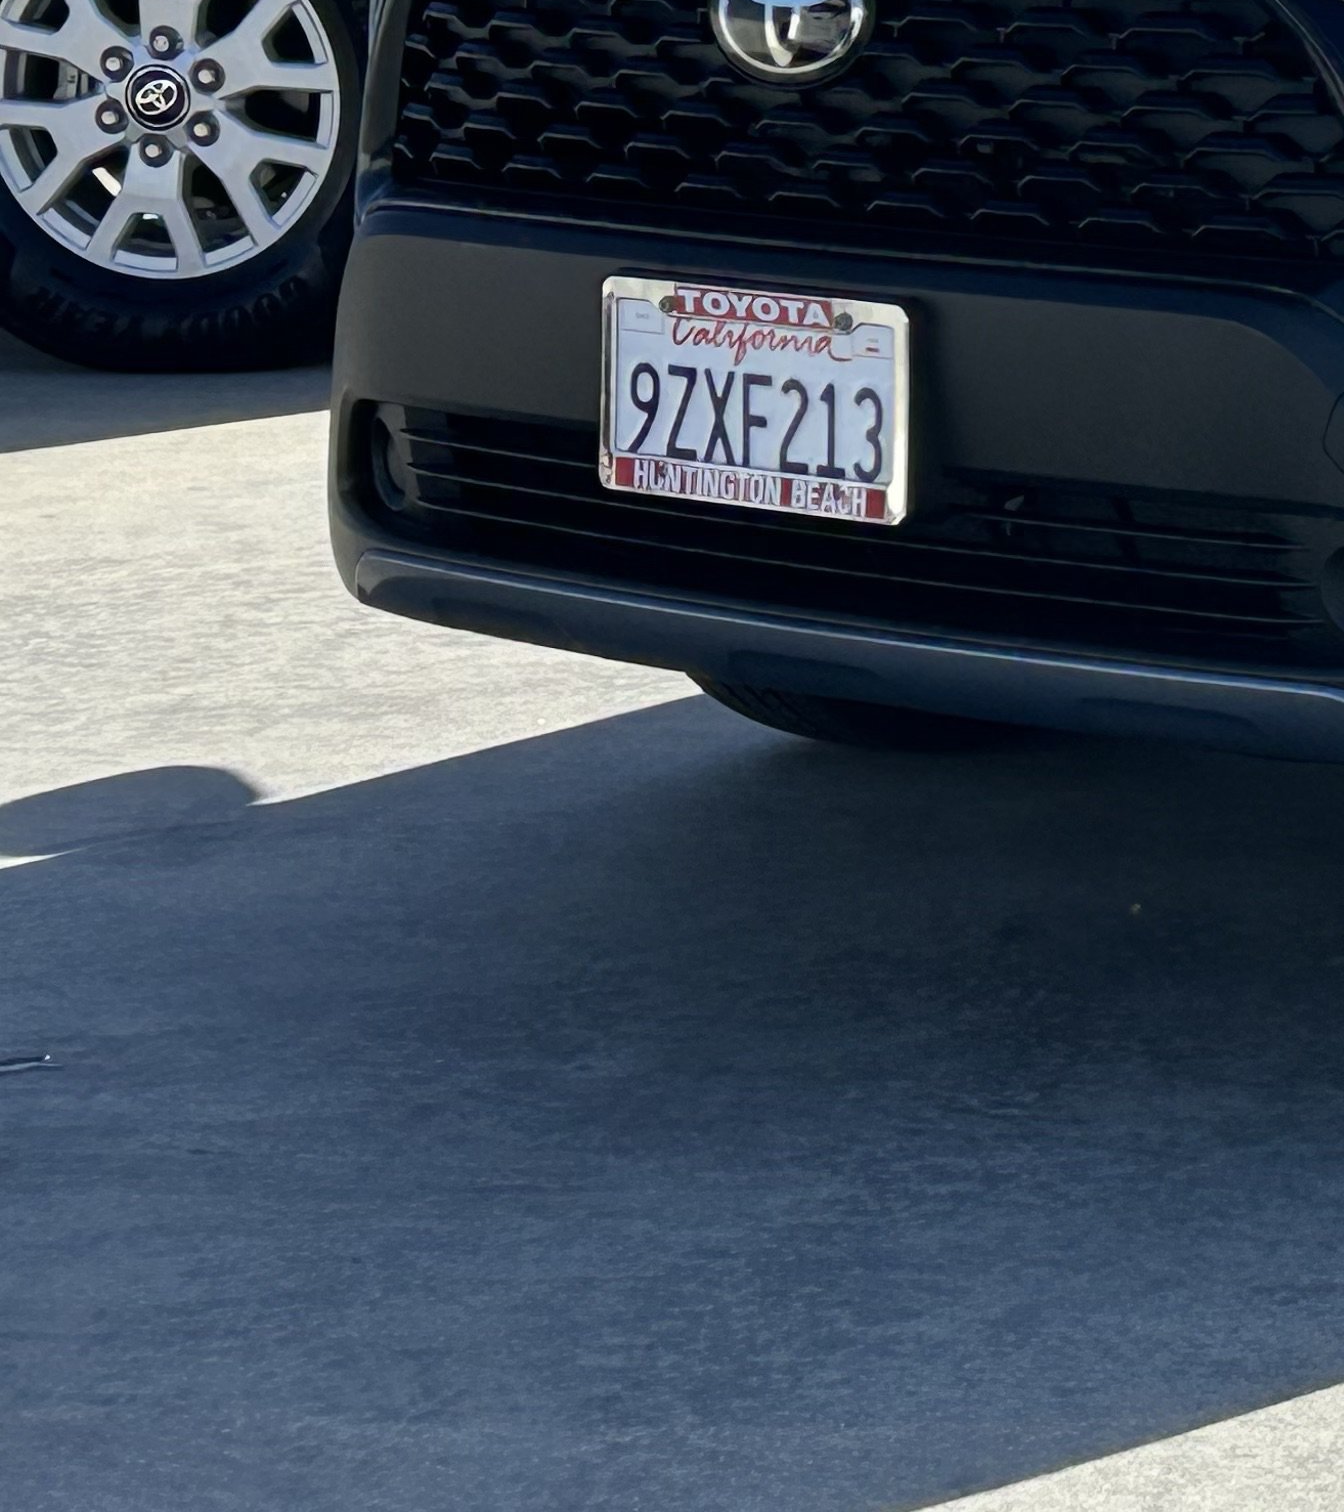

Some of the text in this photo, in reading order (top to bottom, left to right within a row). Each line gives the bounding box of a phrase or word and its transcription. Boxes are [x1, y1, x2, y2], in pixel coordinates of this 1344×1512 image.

[675, 288, 832, 327] TOYOTA
[671, 317, 853, 366] California
[627, 361, 883, 483] 9ZXF213
[632, 458, 867, 519] HUNTINGTON BEACH
